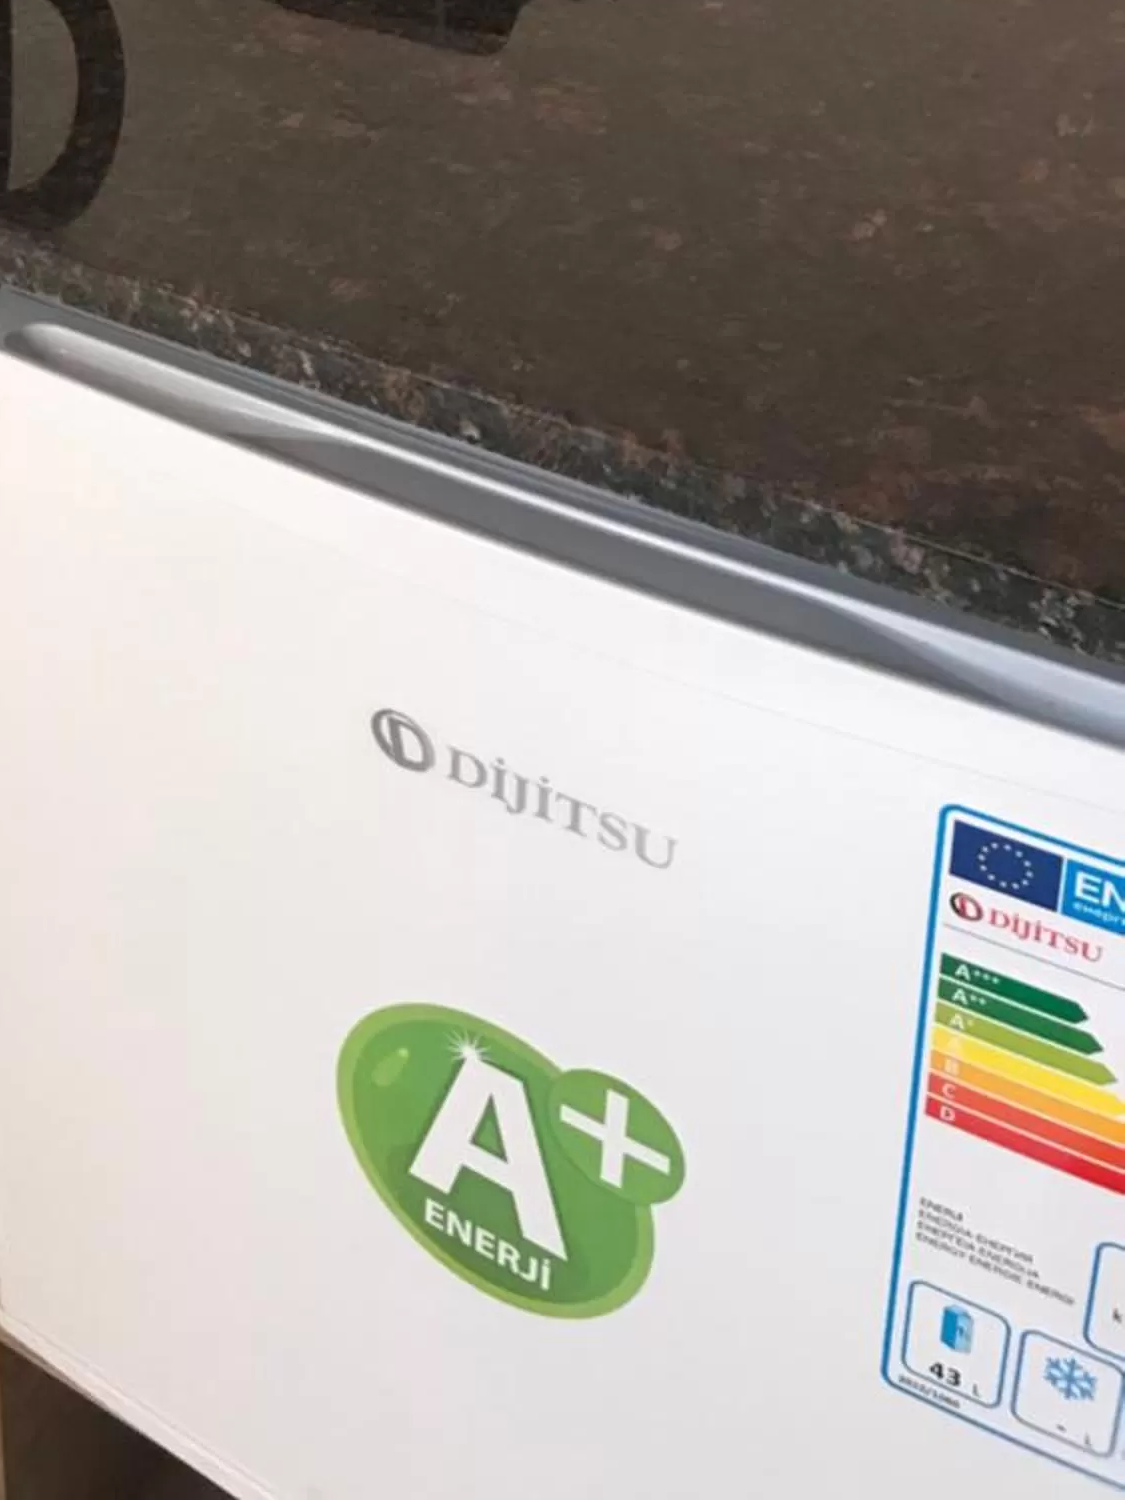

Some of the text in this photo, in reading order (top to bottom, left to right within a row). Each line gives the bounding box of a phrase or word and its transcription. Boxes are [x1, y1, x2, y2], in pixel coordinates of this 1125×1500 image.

[942, 1083, 956, 1099] C
[940, 1105, 956, 1122] D
[928, 1363, 961, 1387] 43
